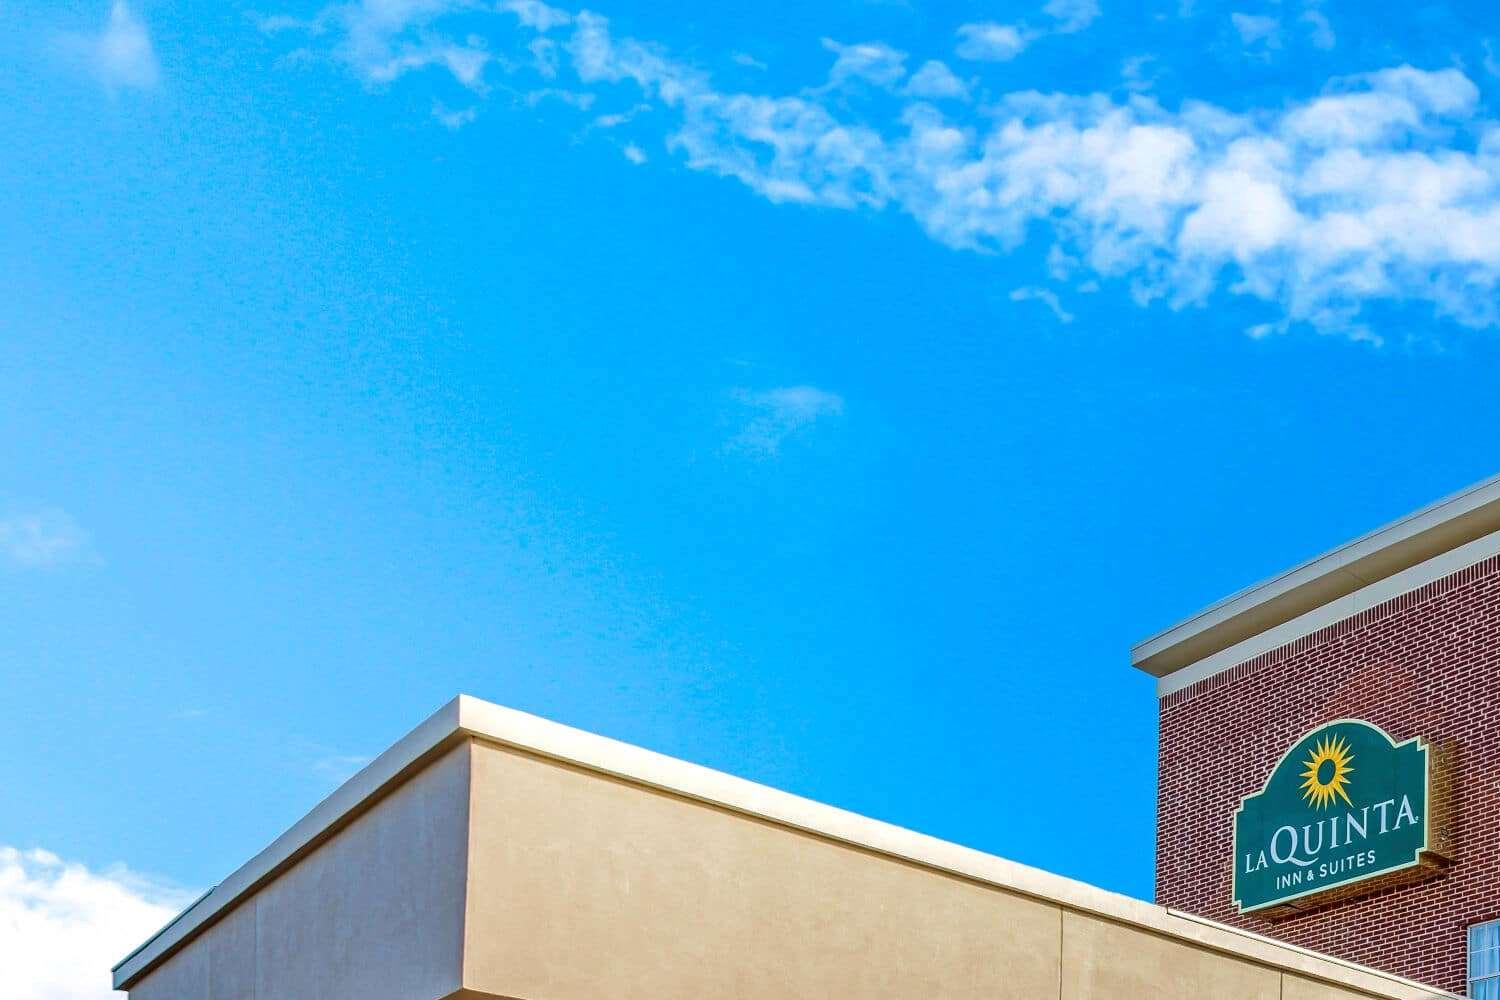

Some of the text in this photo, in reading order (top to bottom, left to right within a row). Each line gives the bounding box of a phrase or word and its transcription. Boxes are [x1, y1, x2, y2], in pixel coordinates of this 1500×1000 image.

[1245, 794, 1417, 873] LA QUINTA
[1276, 850, 1376, 890] INN & SUITES
